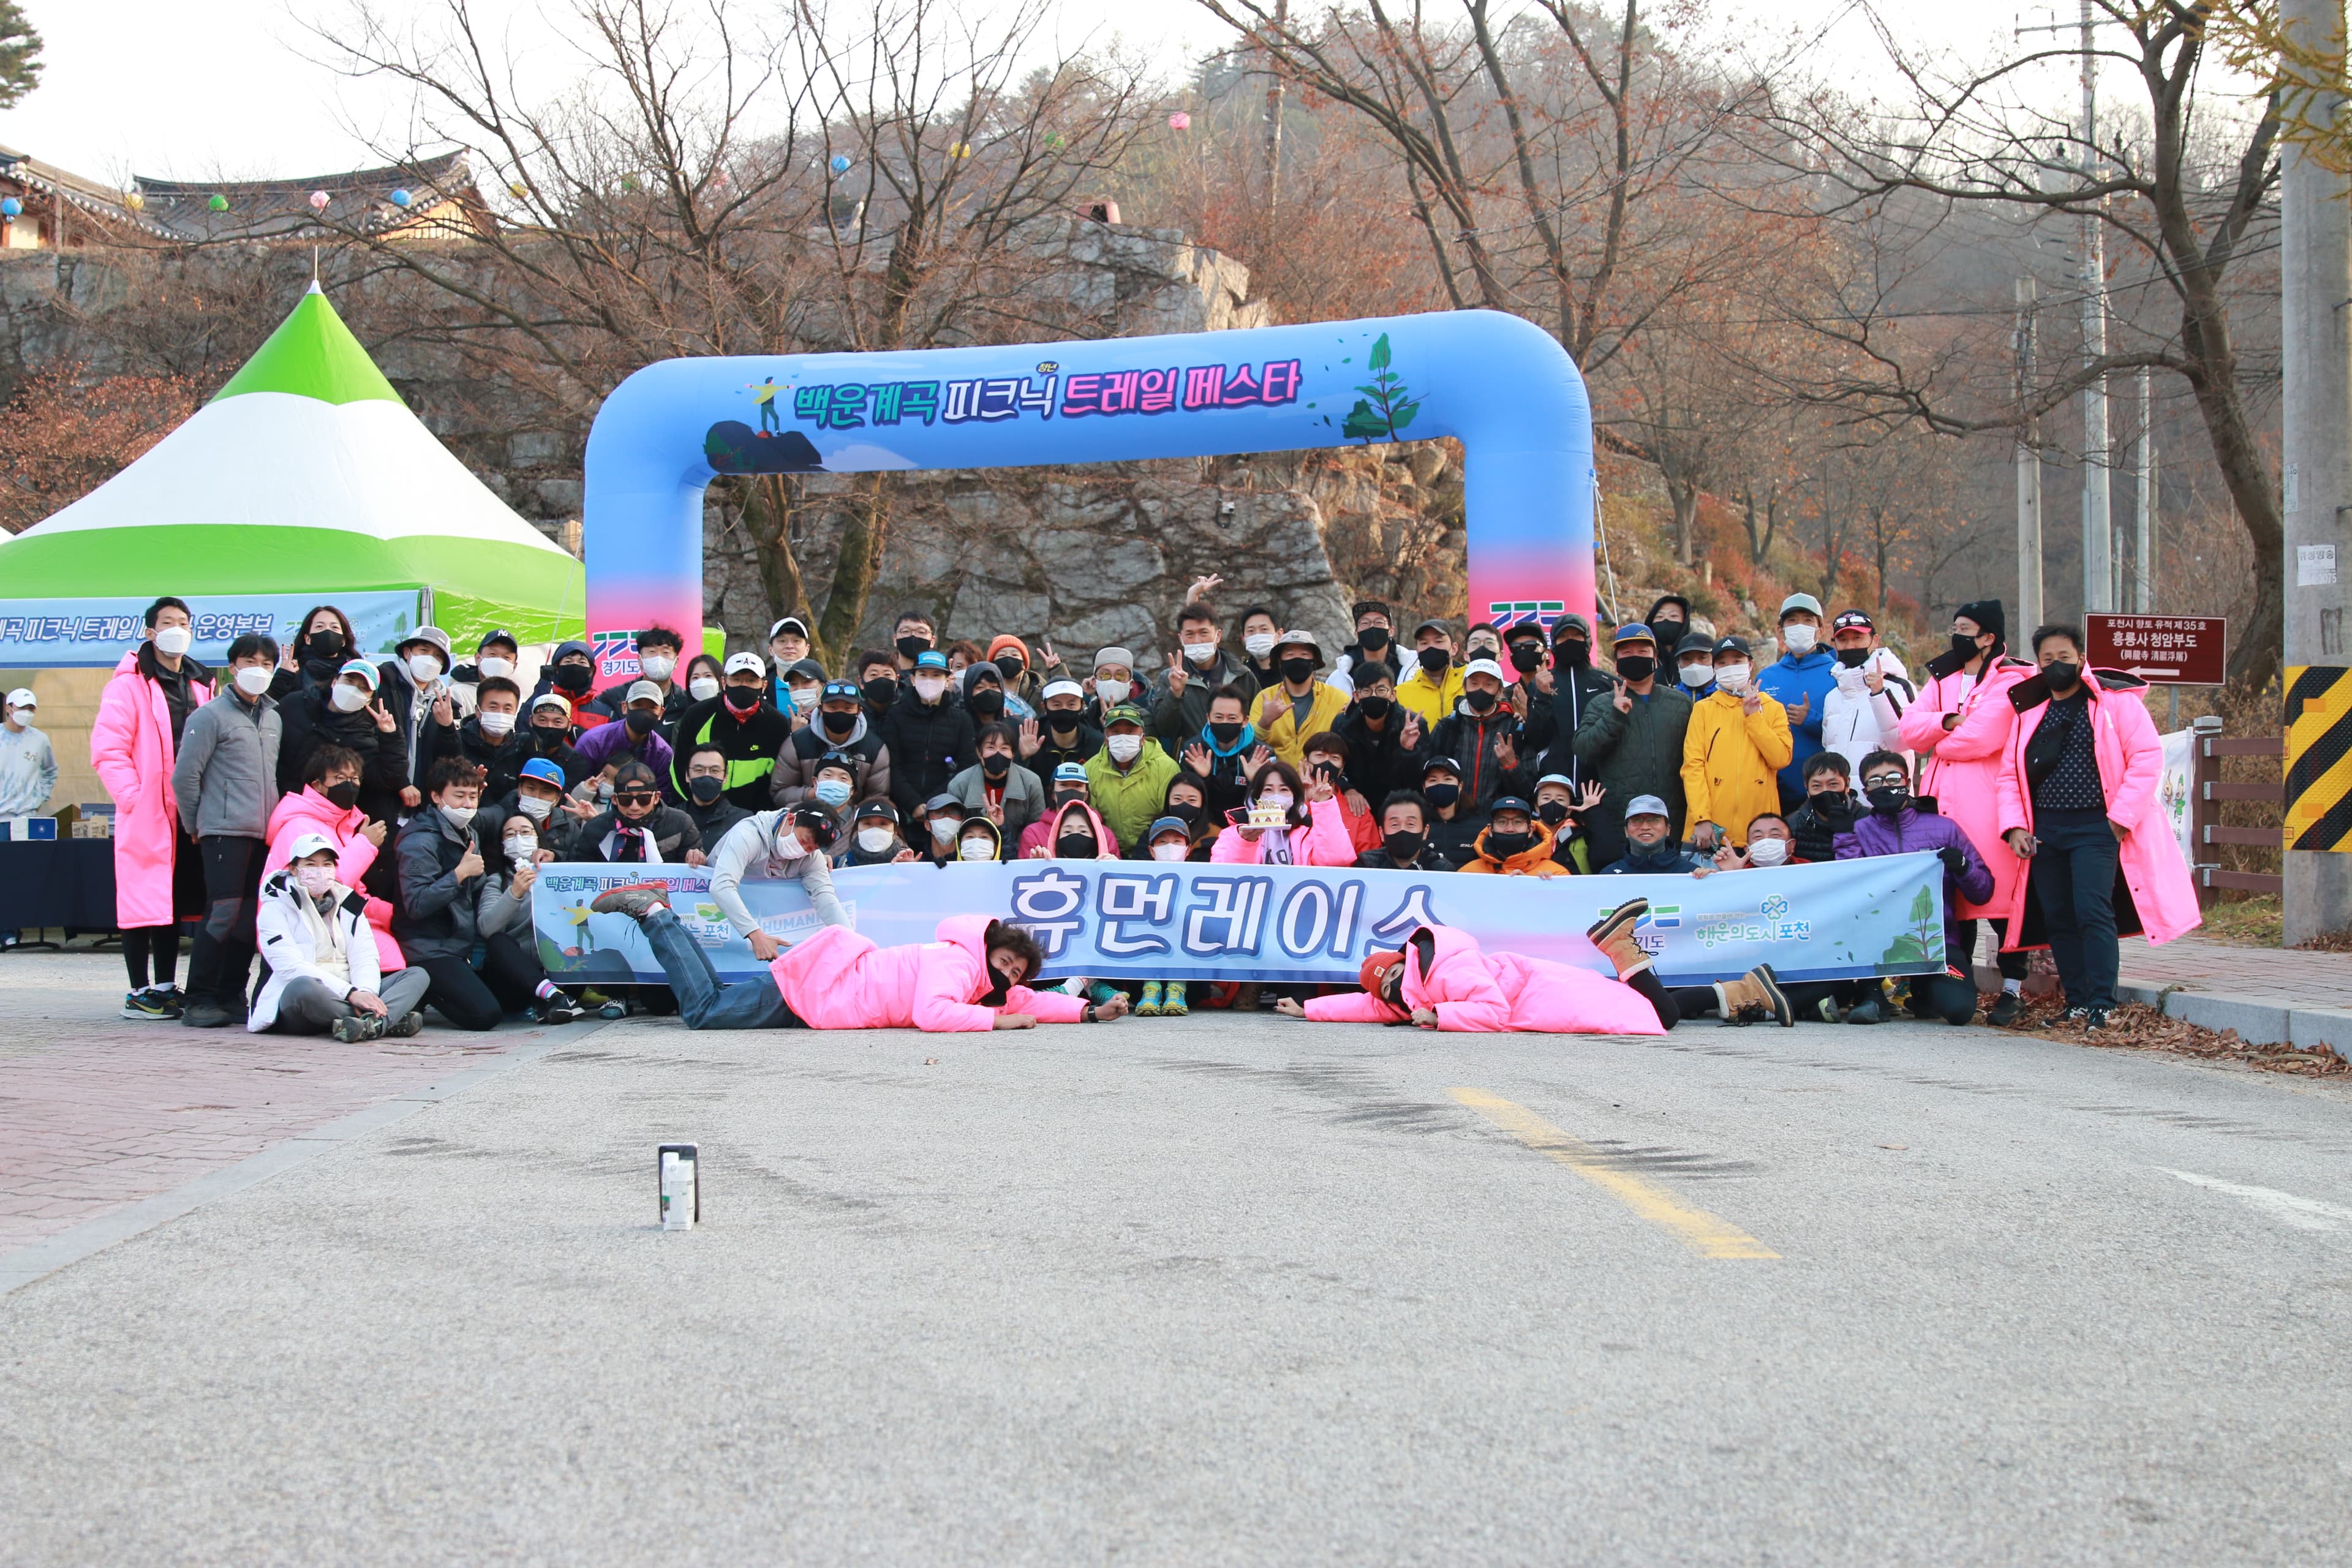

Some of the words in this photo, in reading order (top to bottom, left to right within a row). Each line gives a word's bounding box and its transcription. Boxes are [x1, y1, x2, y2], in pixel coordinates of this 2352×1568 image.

[1038, 363, 1058, 372] 청년
[796, 382, 938, 428] 백운계곡
[944, 377, 1055, 420] 피크닉
[1063, 370, 1176, 413] 트레일
[1184, 361, 1300, 407] 페스타
[0, 616, 23, 643] 곡
[25, 616, 80, 641] 피크닉
[81, 615, 136, 640] 트레일
[197, 614, 273, 639] 운영본부
[2107, 619, 2133, 628] 포천시
[2136, 619, 2153, 629] 향토
[2155, 620, 2173, 630] 유적
[2174, 620, 2207, 631] 제35호
[2113, 631, 2149, 647] 흥룡사
[2150, 633, 2198, 648] 청암부도
[603, 660, 640, 675] 경기도
[546, 876, 598, 892] 백운계곡
[681, 878, 712, 892] 페스
[1006, 869, 1443, 957] 휴먼레이스
[703, 924, 729, 940] 포천
[1696, 921, 1776, 948] 행운의도시
[1779, 921, 1810, 940] 포천
[1636, 935, 1665, 949] 기도
